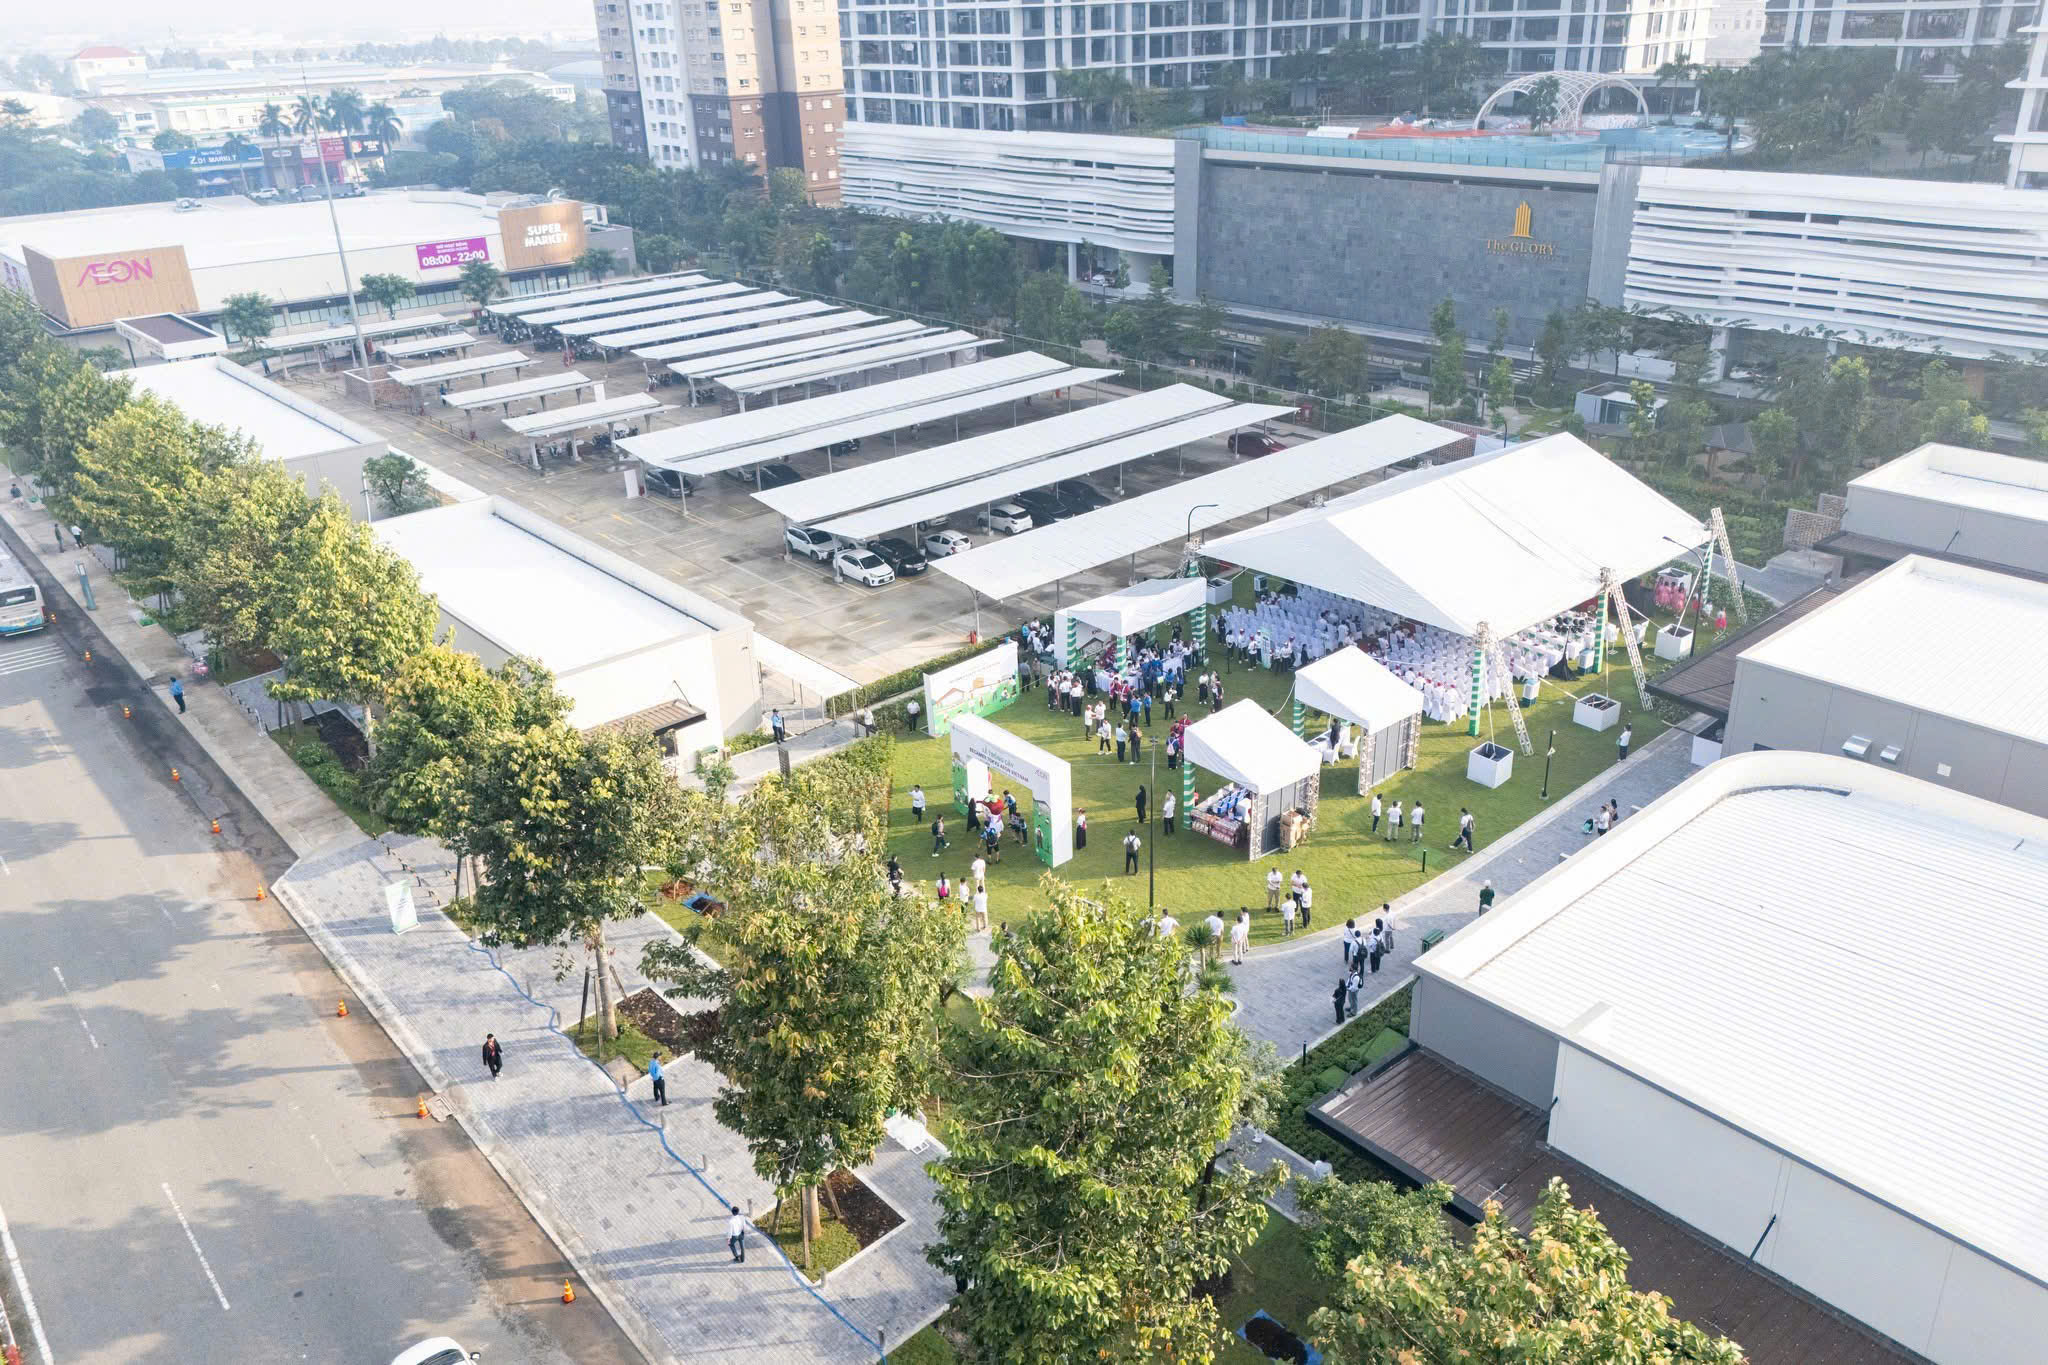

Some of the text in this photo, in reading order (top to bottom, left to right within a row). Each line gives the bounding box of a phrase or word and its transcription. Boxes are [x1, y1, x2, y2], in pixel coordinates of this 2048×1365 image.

[528, 224, 561, 235] SUPER
[525, 233, 568, 247] MARKET
[1511, 241, 1553, 255] GLORY
[422, 255, 451, 266] 08:00
[457, 250, 485, 262] 22:00
[1011, 769, 1029, 783] VIETNAM
